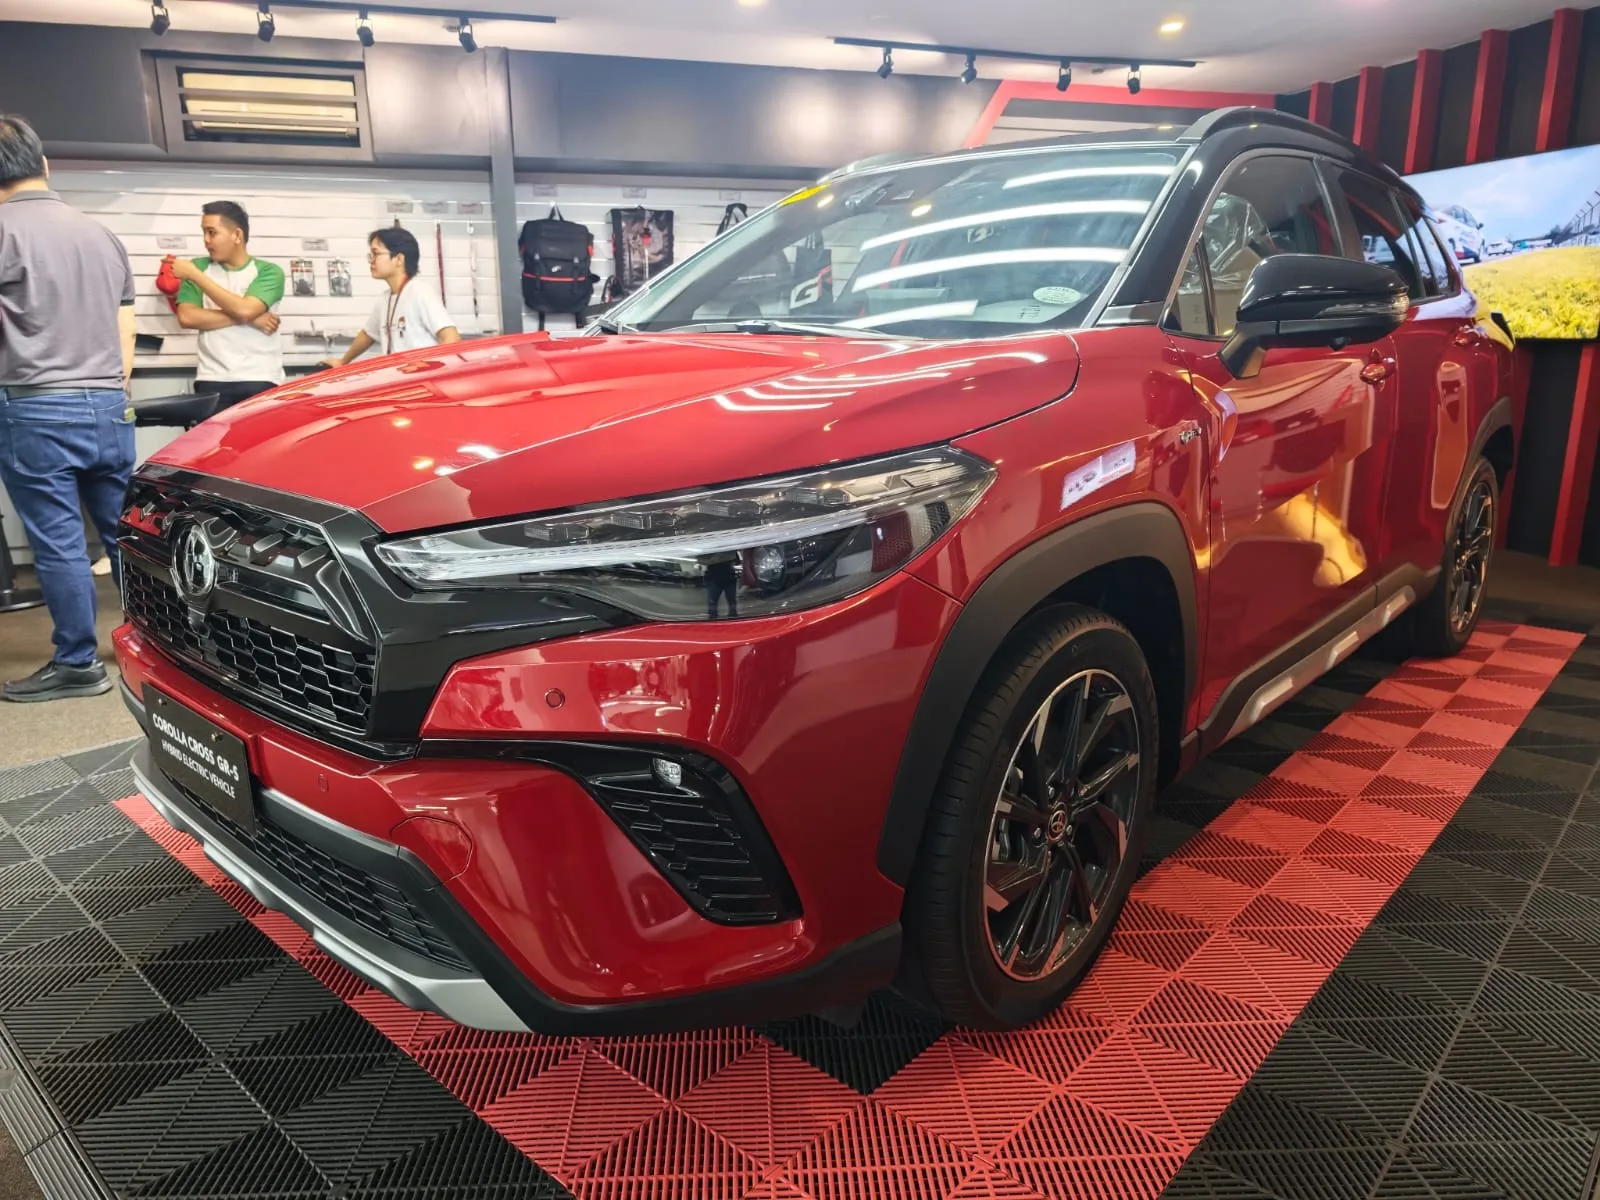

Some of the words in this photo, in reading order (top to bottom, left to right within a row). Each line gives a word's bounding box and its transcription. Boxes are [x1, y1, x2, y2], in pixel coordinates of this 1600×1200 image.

[152, 713, 187, 748] COROLLA
[187, 736, 215, 765] CROSS
[216, 755, 240, 782] GR-S
[162, 739, 183, 761] HYBRID
[182, 752, 209, 780] ELECTRIC
[209, 773, 236, 799] VEHICLE
